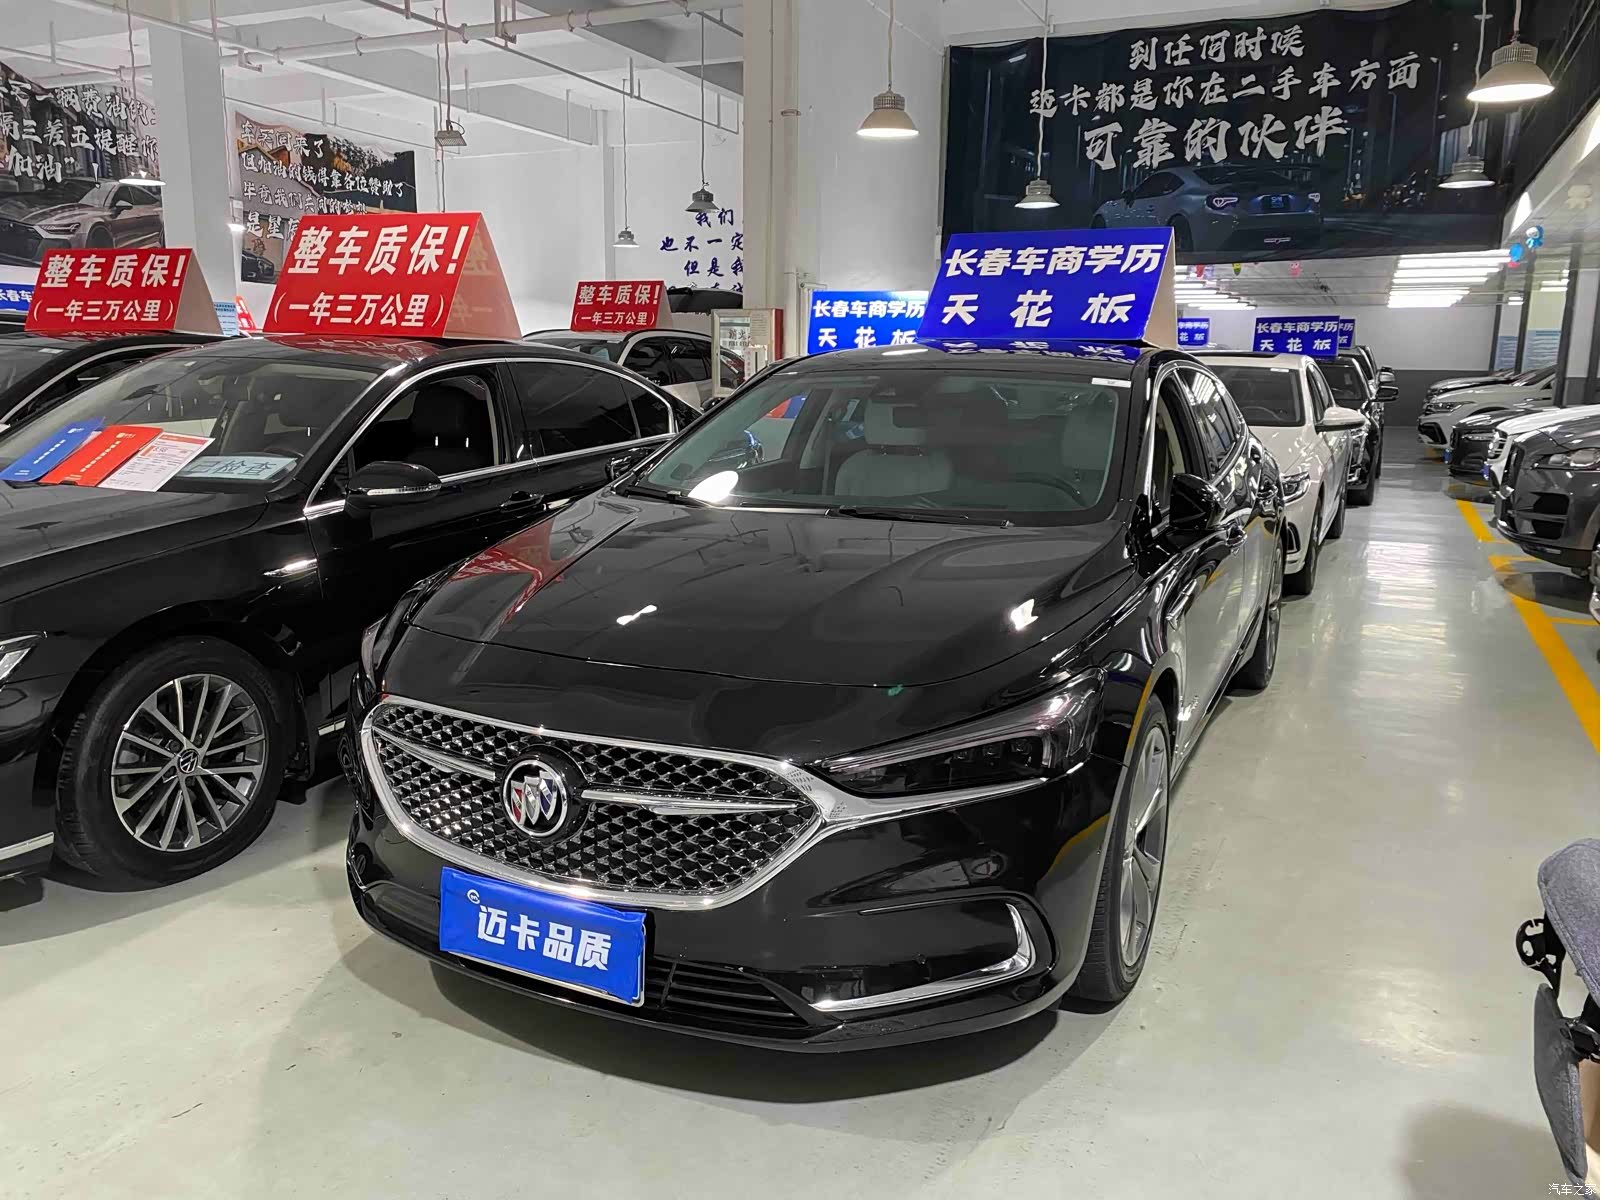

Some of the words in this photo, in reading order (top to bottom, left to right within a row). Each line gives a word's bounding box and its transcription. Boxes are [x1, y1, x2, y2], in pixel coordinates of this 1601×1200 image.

[1129, 24, 1305, 71] 到任何时候
[1028, 51, 1423, 118] 迈卡都是你在二手车方面
[241, 120, 324, 159] 车买回来了
[1083, 105, 1349, 170] 可靠的伙伴
[241, 152, 405, 199] 但加油的钱得靠各位赞助了
[288, 225, 469, 275] 整车质保！
[660, 232, 743, 252] 也不一定
[41, 254, 186, 288] 整车质保！
[945, 244, 1165, 278] 长春车商学历
[33, 300, 174, 322] （一年三万公里）
[273, 291, 445, 328] （一年三万公里）
[577, 284, 660, 306] 整车质保！
[813, 300, 925, 319] 长春车商学历
[941, 289, 1137, 328] 天花板
[574, 311, 655, 326] （一年三万公里）
[1256, 321, 1338, 333] 长春车商学历
[818, 326, 918, 349] 天花板
[1260, 337, 1332, 351] 天花板
[477, 905, 612, 971] 迈卡品质
